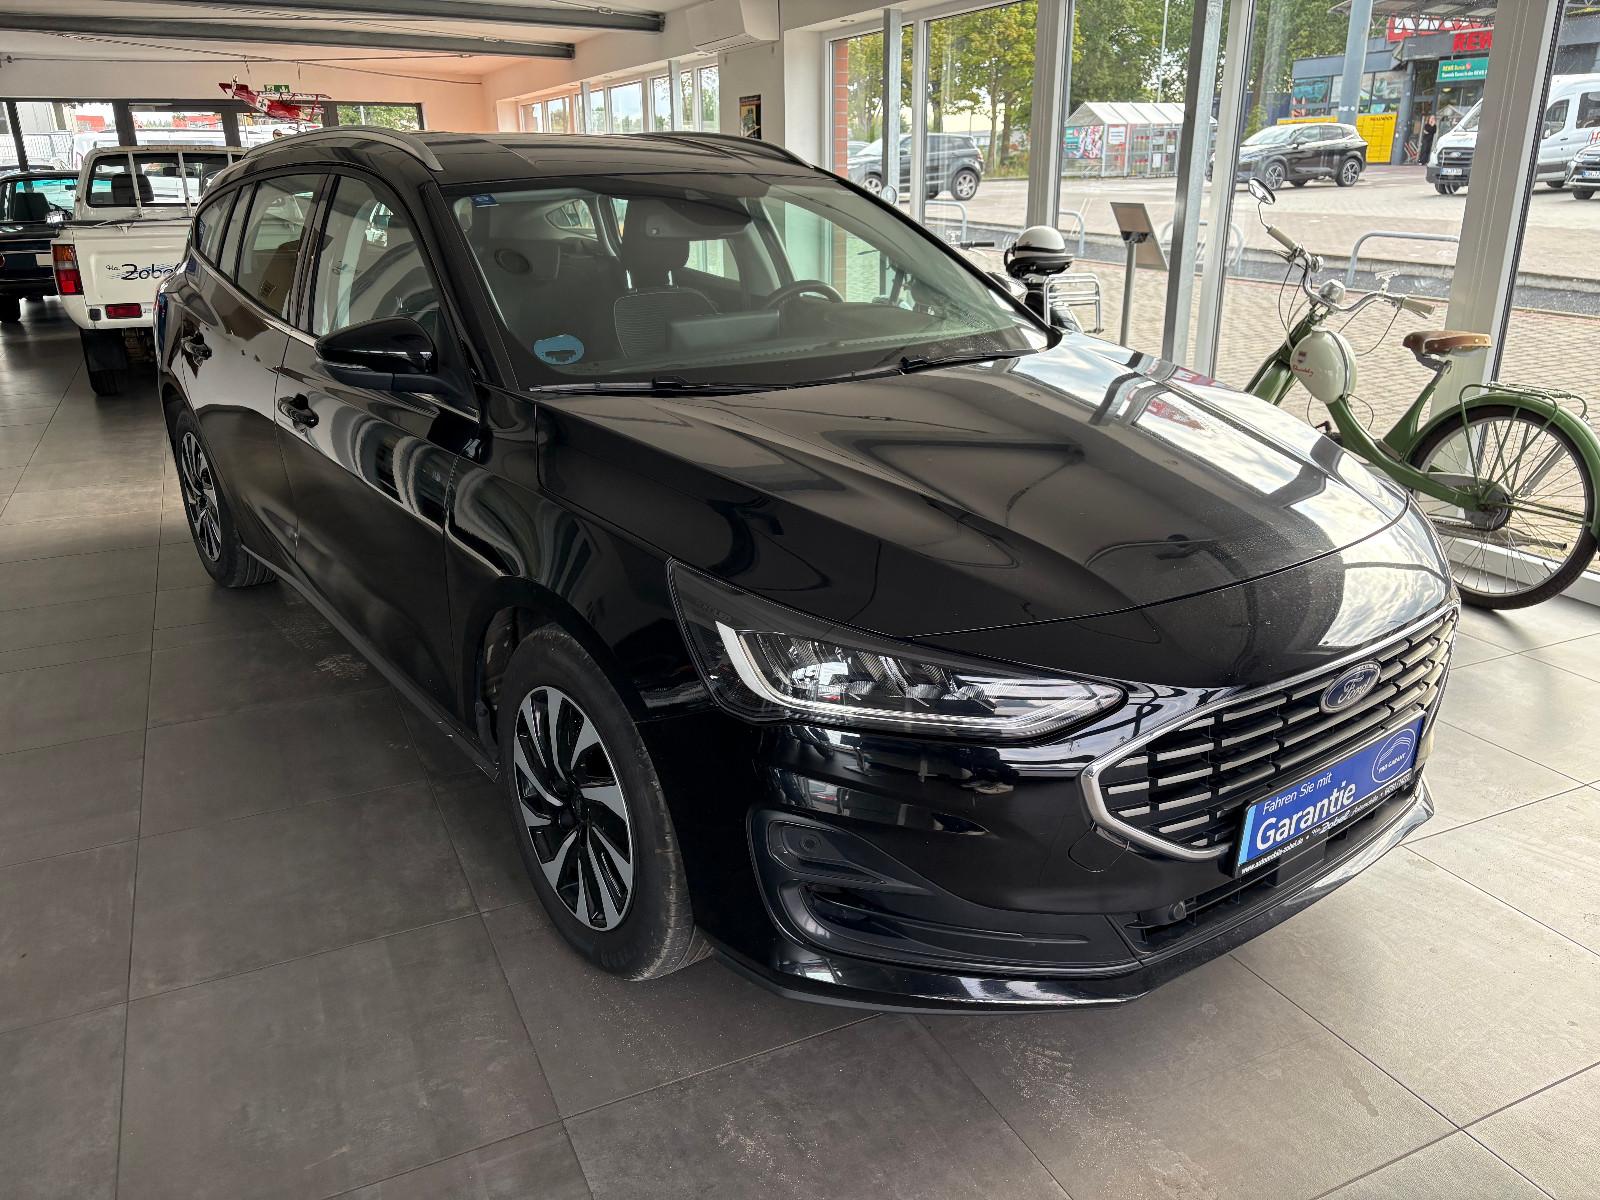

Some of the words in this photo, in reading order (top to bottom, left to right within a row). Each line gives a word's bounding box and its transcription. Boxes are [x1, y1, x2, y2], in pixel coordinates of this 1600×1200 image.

[1451, 31, 1493, 52] REW
[1338, 674, 1371, 704] Ford
[1262, 791, 1297, 815] Fahren
[1299, 781, 1315, 797] Sie
[1316, 772, 1332, 789] mit
[1256, 780, 1356, 850] Garantie
